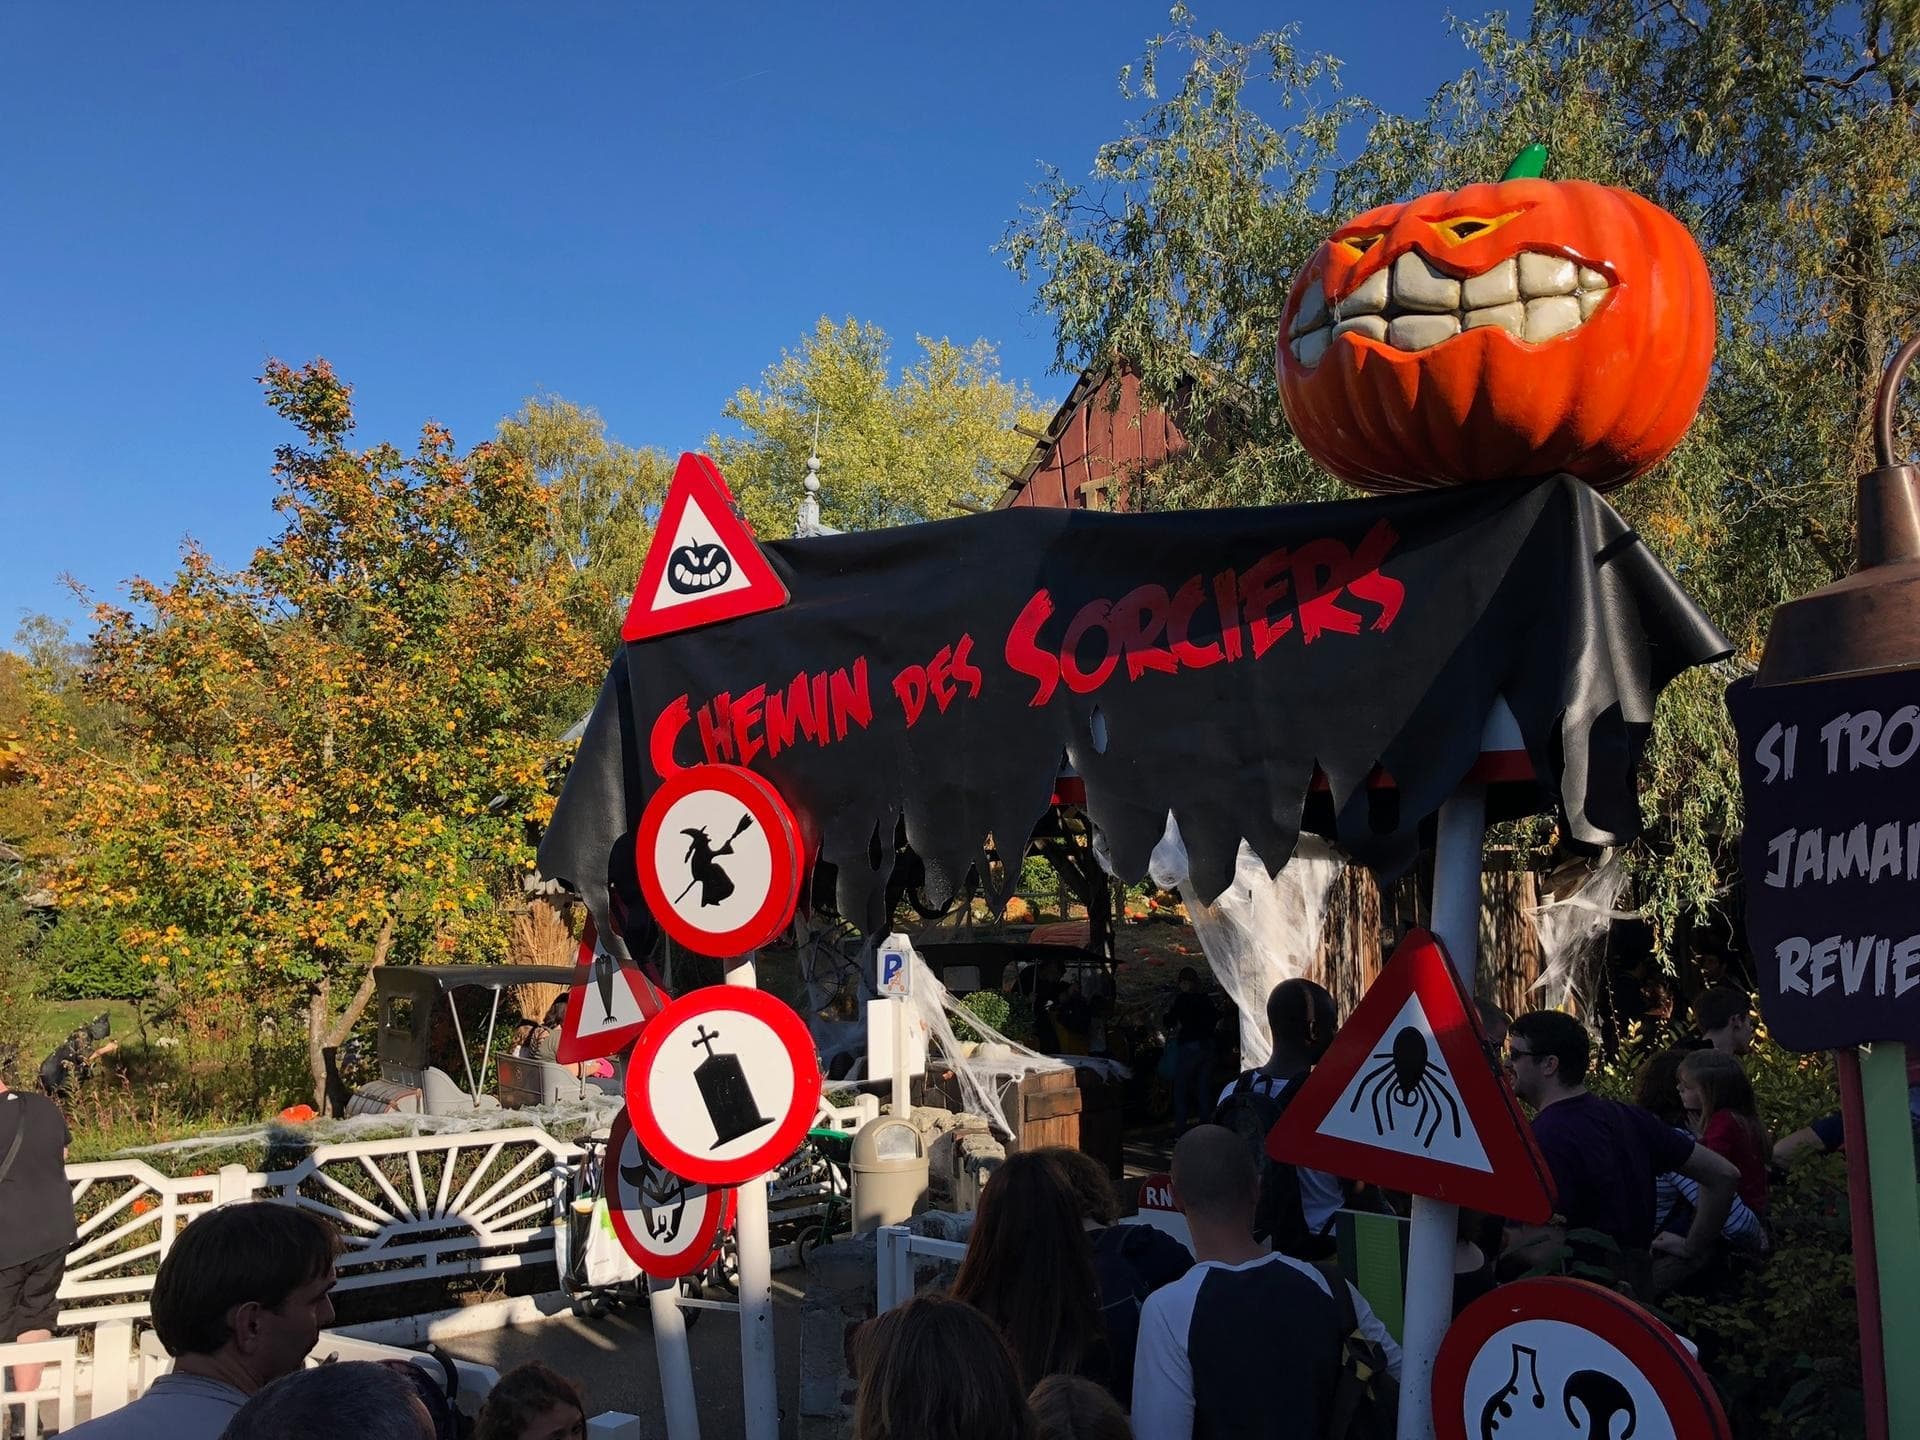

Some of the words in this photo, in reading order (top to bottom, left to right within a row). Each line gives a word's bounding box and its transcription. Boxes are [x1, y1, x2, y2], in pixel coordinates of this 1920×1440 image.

[650, 656, 873, 780] CHEMIN
[892, 632, 982, 728] DES
[1004, 518, 1405, 706] SORCIERS
[1755, 721, 1798, 785] SI
[883, 954, 902, 984] P
[1775, 934, 1920, 998] REVIE
